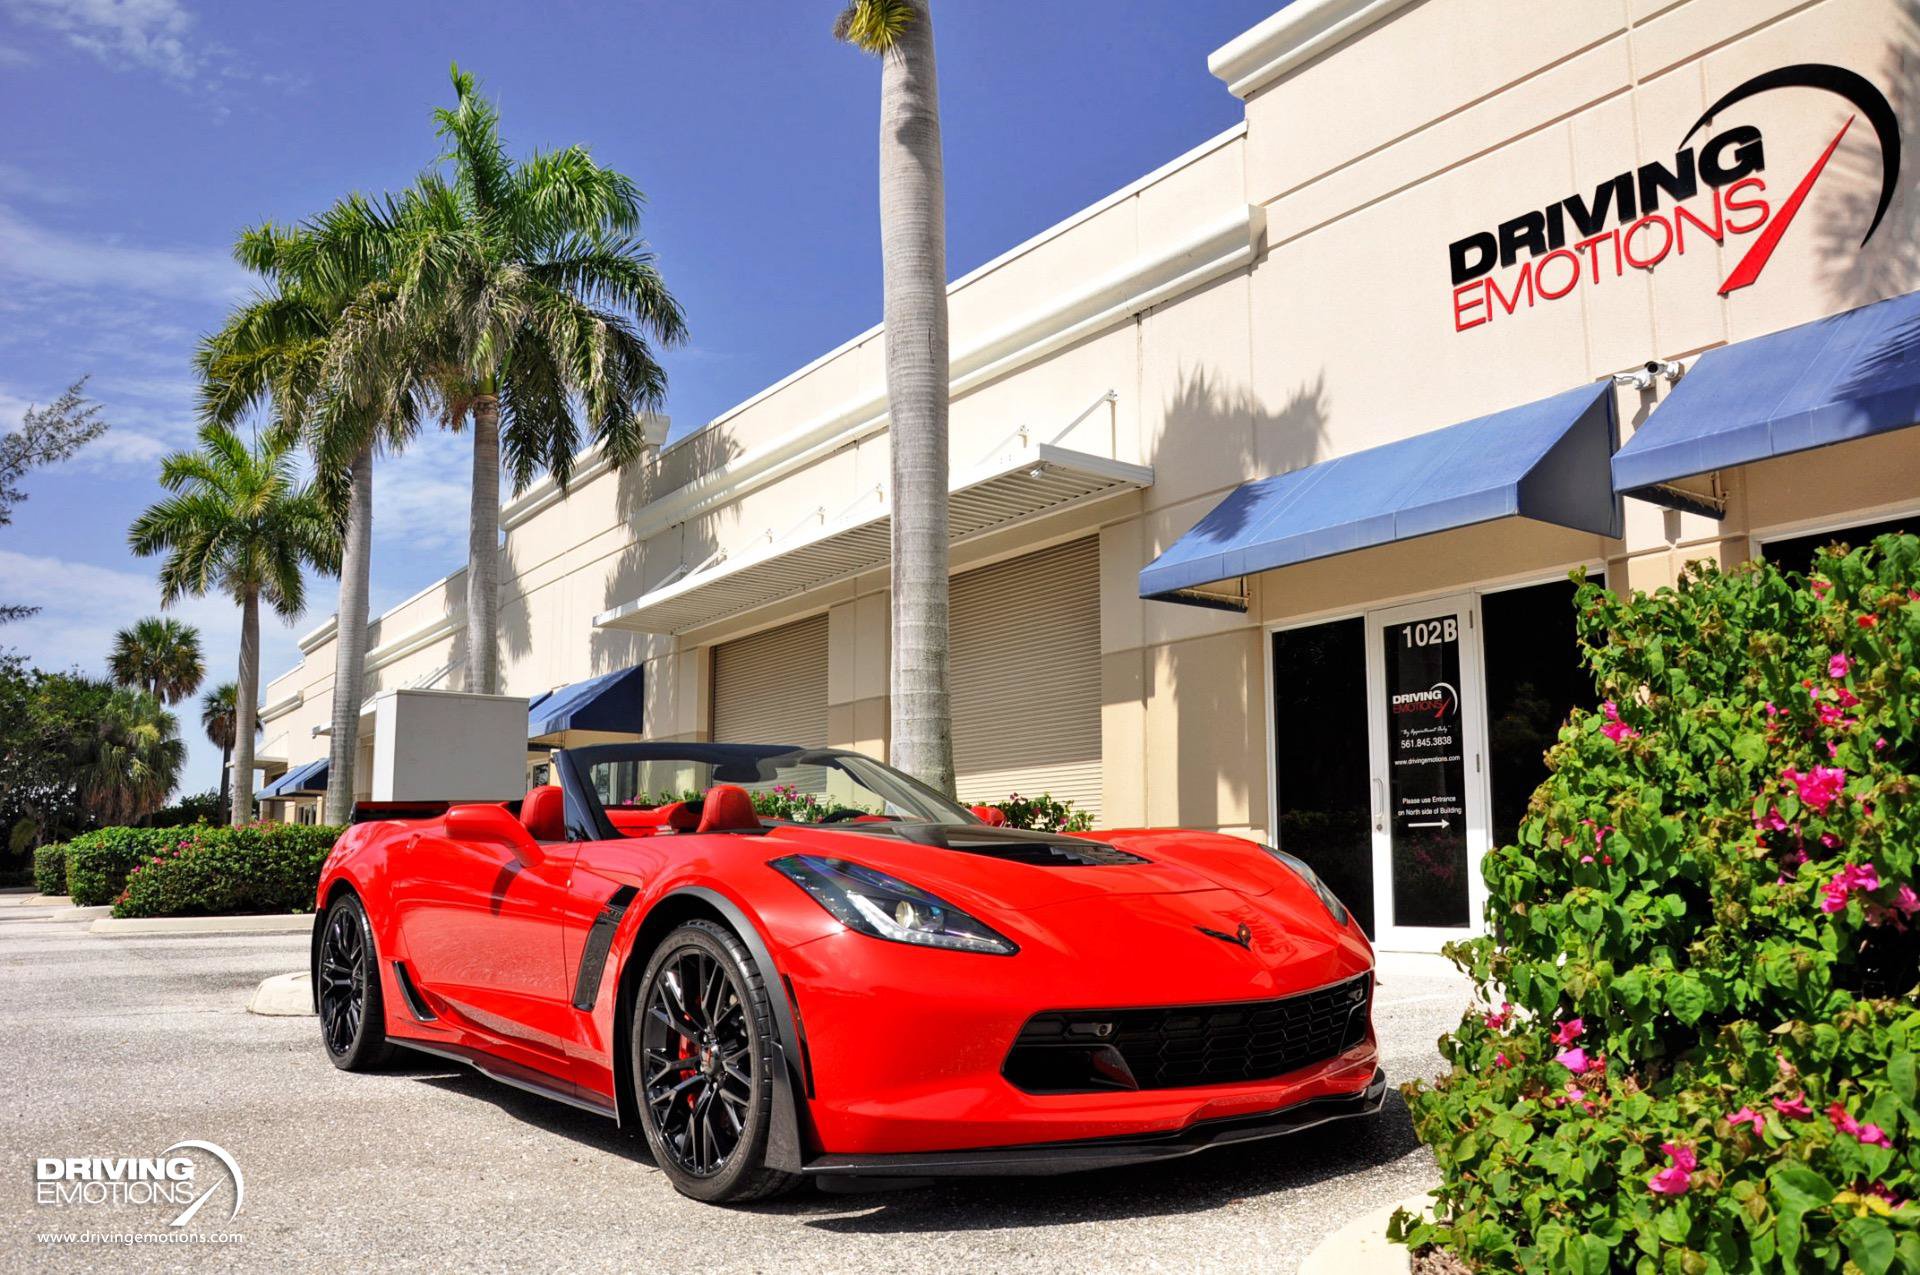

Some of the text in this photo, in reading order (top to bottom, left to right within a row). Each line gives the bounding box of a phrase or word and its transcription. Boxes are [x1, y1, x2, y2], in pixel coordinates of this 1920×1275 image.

[1449, 125, 1766, 286] DRIVING
[1453, 177, 1771, 332] EMOTIONS
[1402, 618, 1457, 648] 102B
[1392, 690, 1442, 704] DRIVING
[1393, 701, 1442, 713] EMOTIONS
[1401, 736, 1452, 749] 561.845.3838
[1394, 755, 1460, 765] www.drivingemotions.com
[1405, 808, 1421, 816] North
[1421, 807, 1433, 815] side
[1433, 807, 1440, 815] of
[1440, 807, 1463, 815] Building
